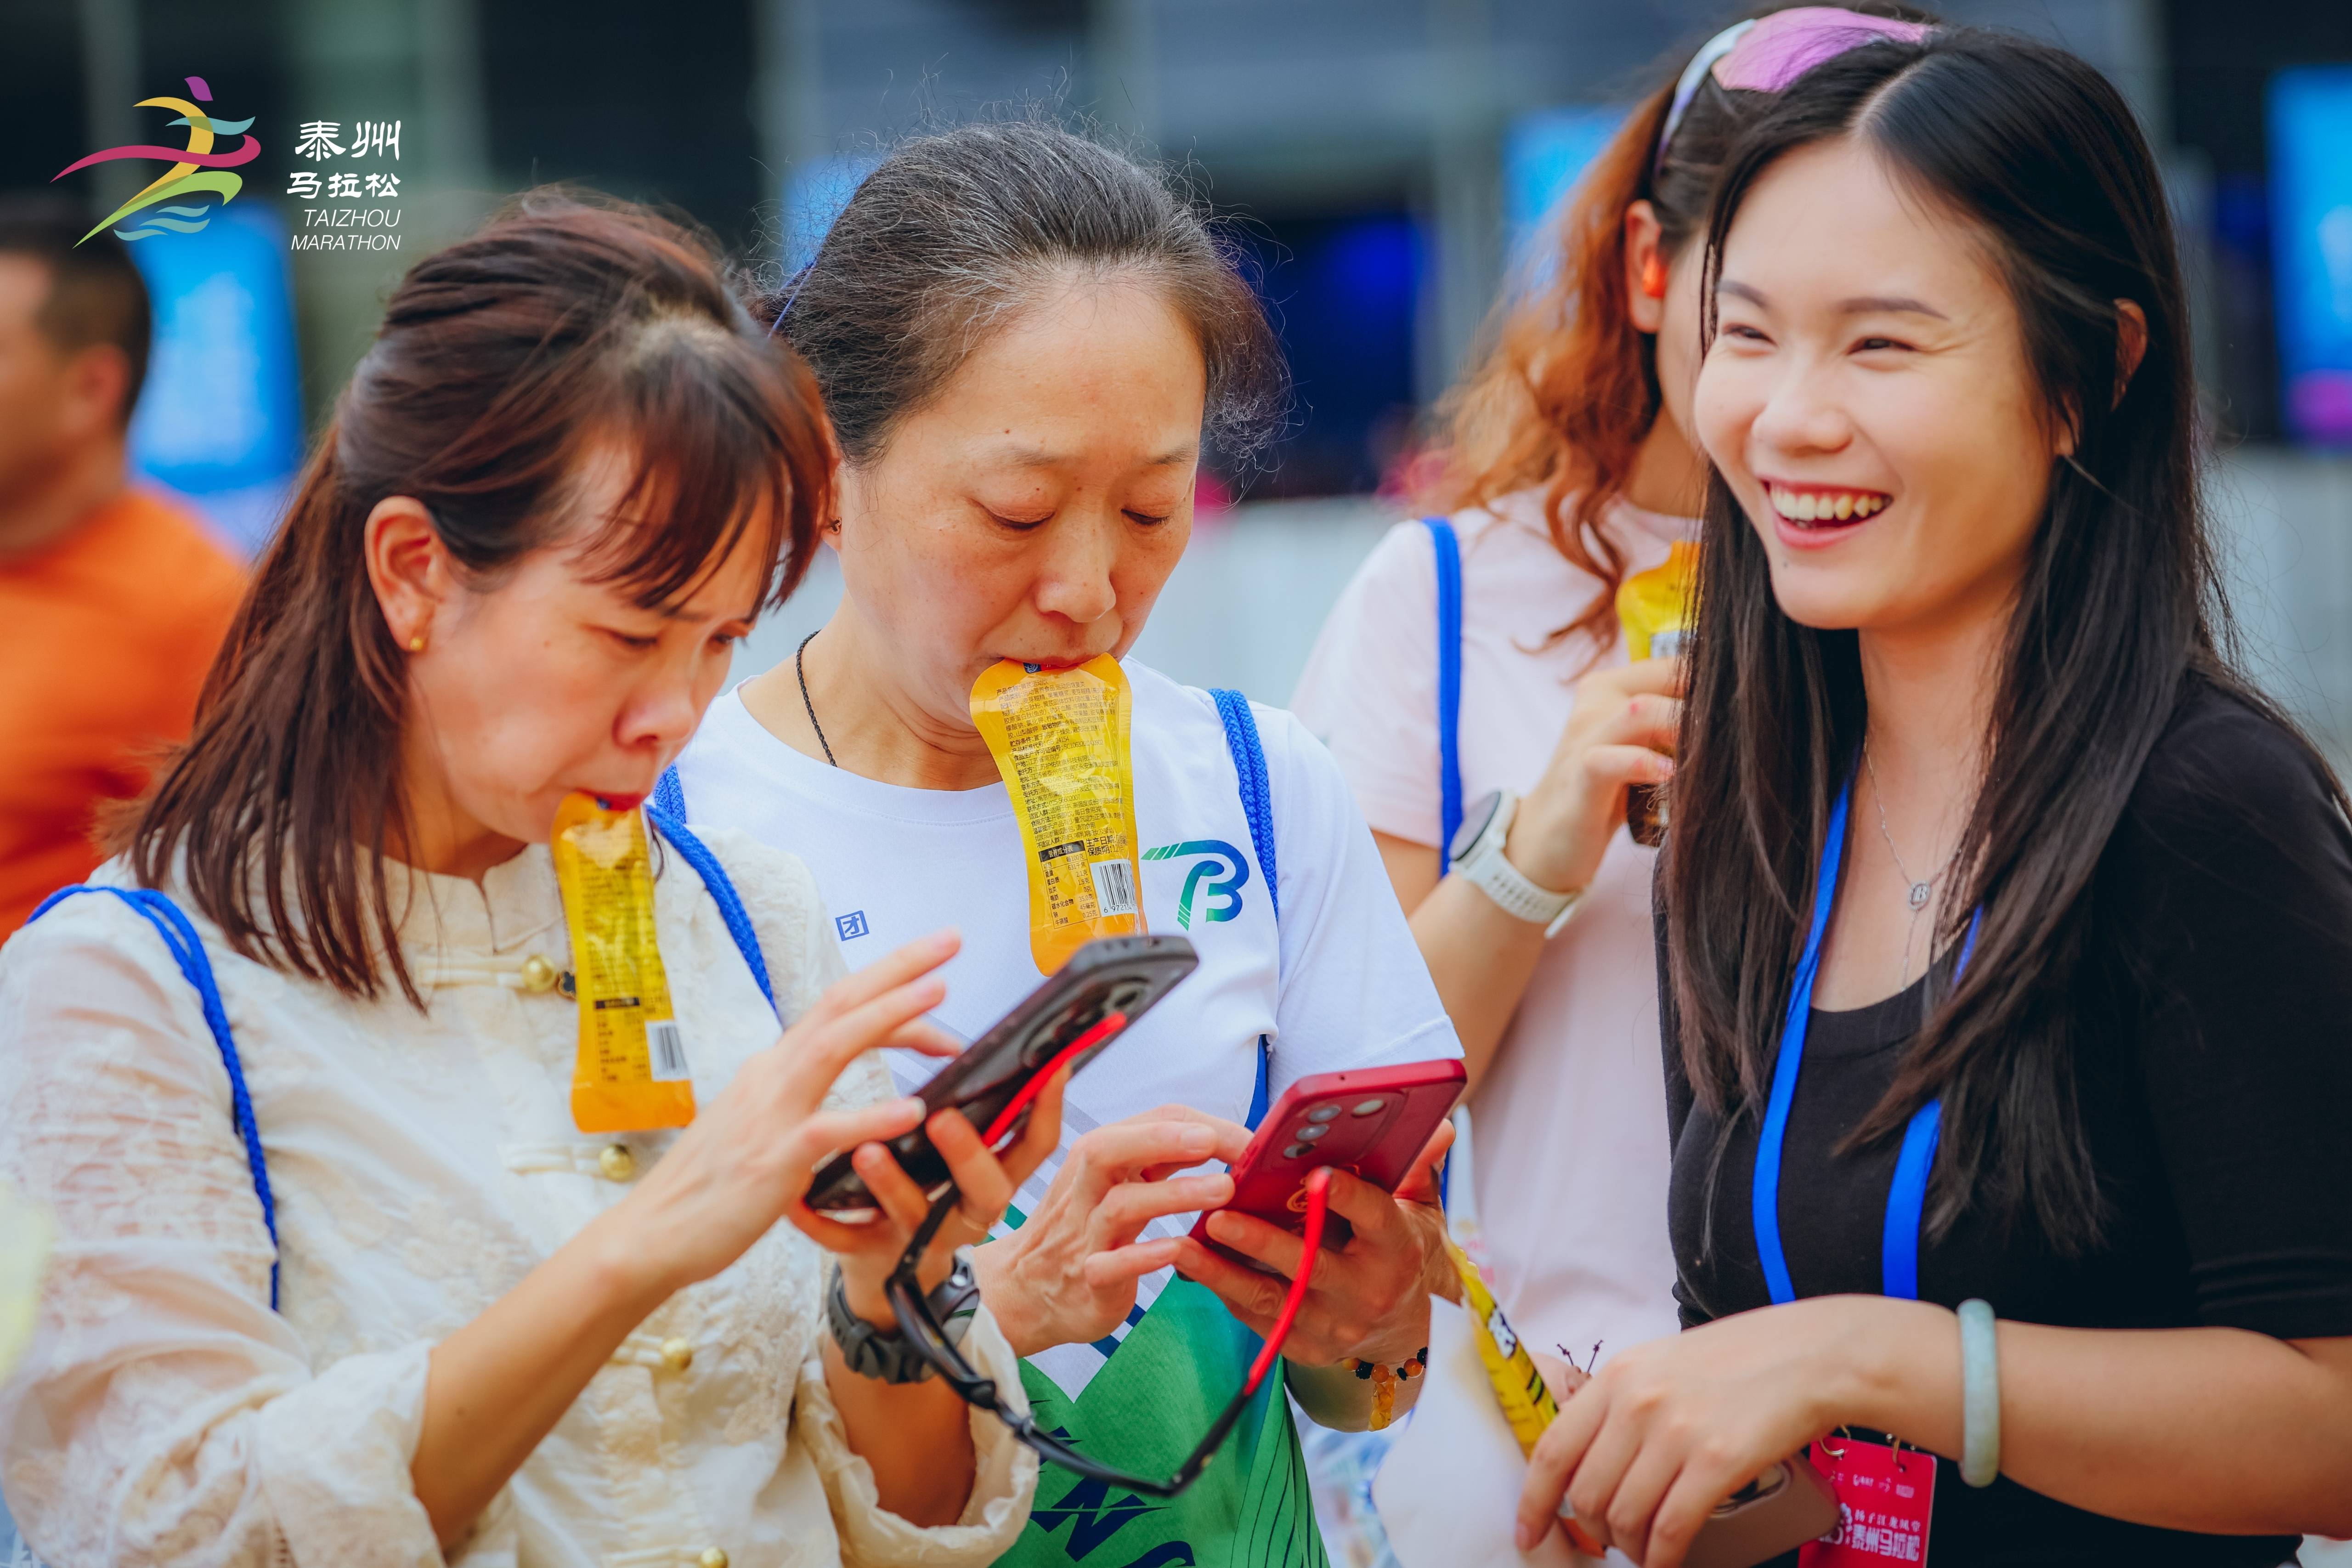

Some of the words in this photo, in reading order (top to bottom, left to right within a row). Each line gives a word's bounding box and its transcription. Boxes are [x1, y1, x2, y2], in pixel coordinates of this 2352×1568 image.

[1049, 845, 1073, 857] 营养成分表
[1066, 854, 1085, 862] 每100克
[1047, 877, 1060, 886] 蛋白质
[1052, 899, 1074, 910] 碳水化合物
[1079, 894, 1094, 902] 35.0克
[835, 910, 869, 941] 团
